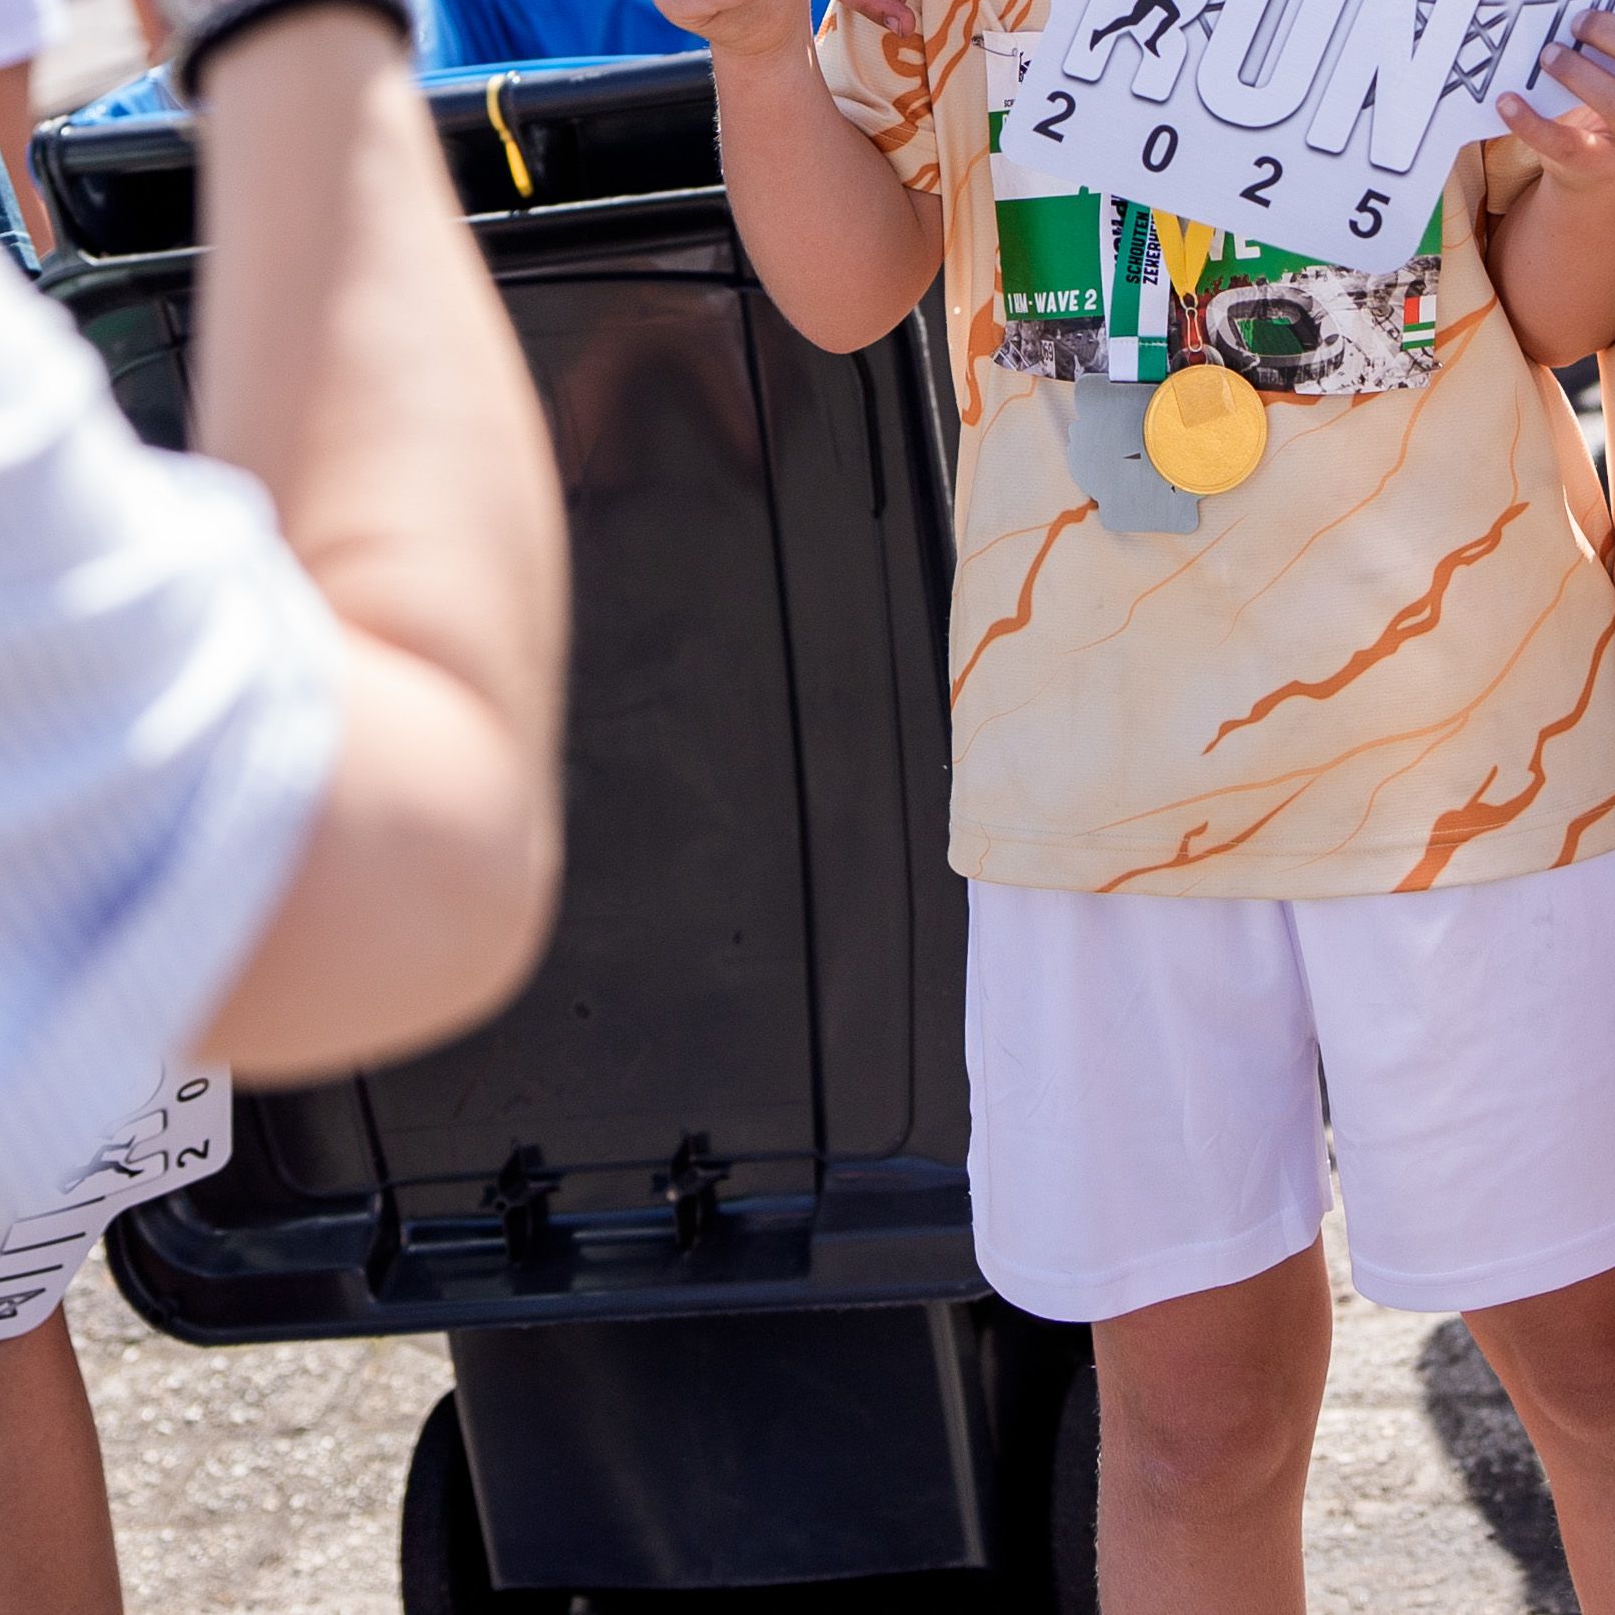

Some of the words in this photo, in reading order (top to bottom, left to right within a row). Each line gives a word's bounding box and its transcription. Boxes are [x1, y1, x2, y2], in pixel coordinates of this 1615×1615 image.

[1126, 211, 1150, 285] SCHOUTEN
[1084, 288, 1097, 311] 2
[176, 1077, 210, 1169] 20
